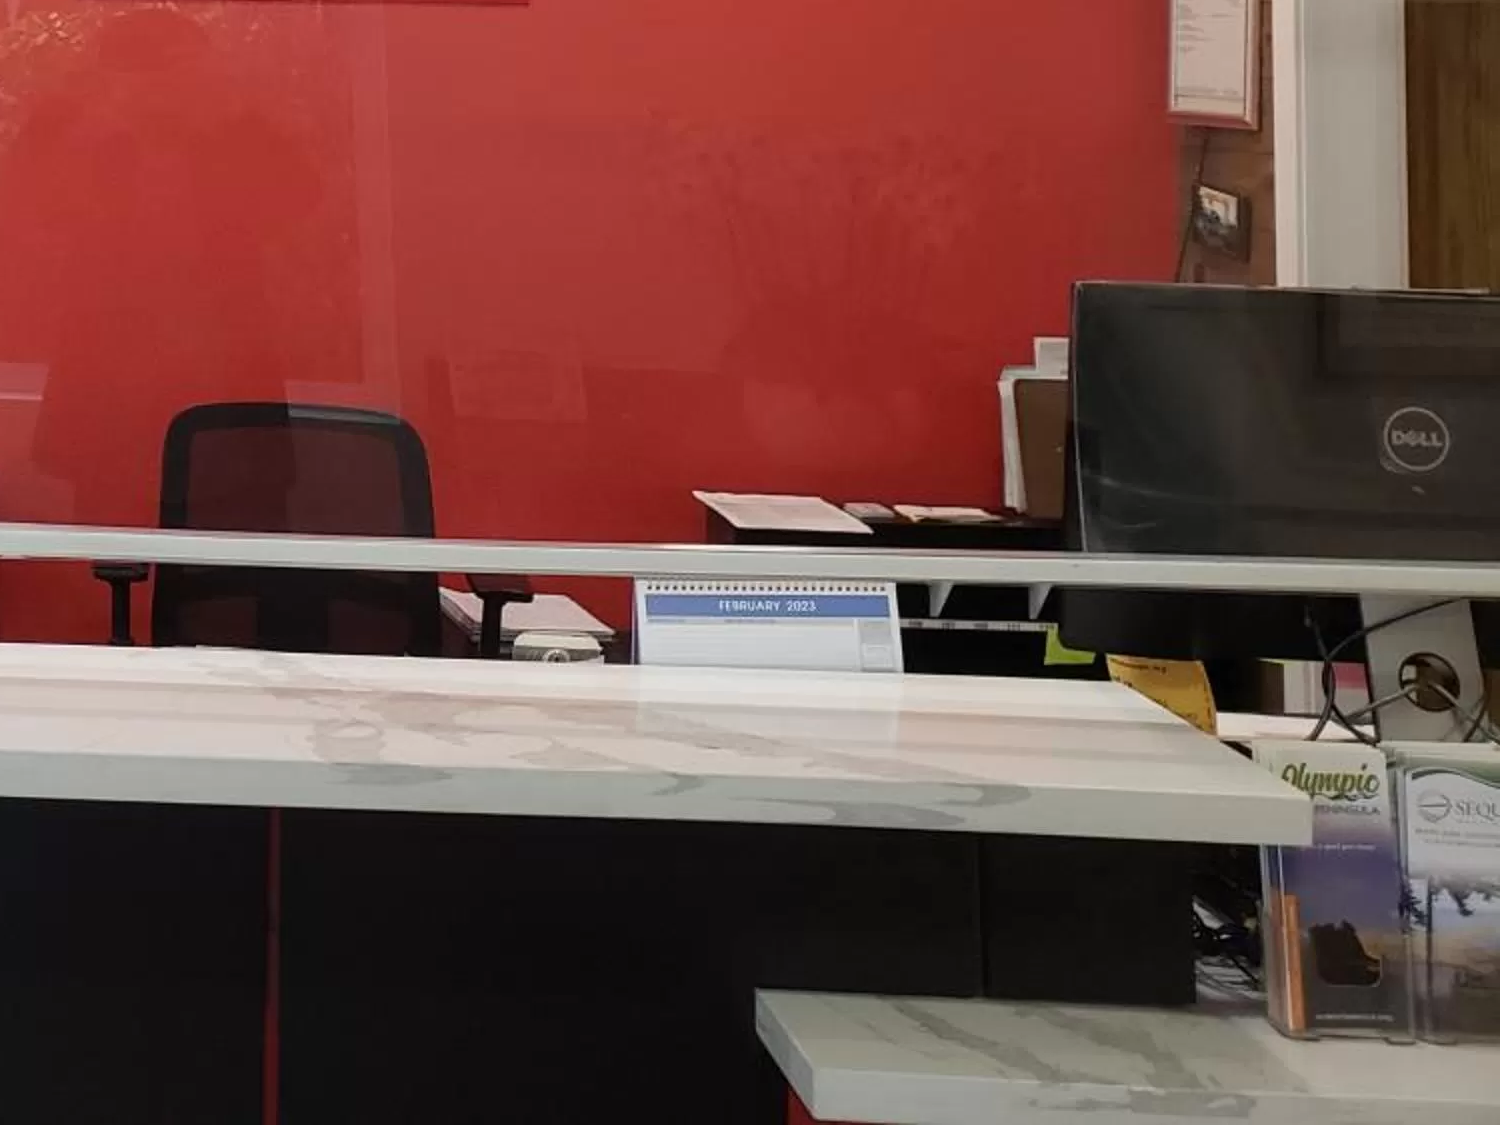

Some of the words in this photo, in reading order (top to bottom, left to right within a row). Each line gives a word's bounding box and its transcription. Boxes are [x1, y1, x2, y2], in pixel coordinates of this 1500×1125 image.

[1391, 430, 1444, 447] DELL
[718, 599, 781, 613] FEBRUARY
[786, 600, 816, 613] 2023
[1281, 762, 1381, 802] Olympic
